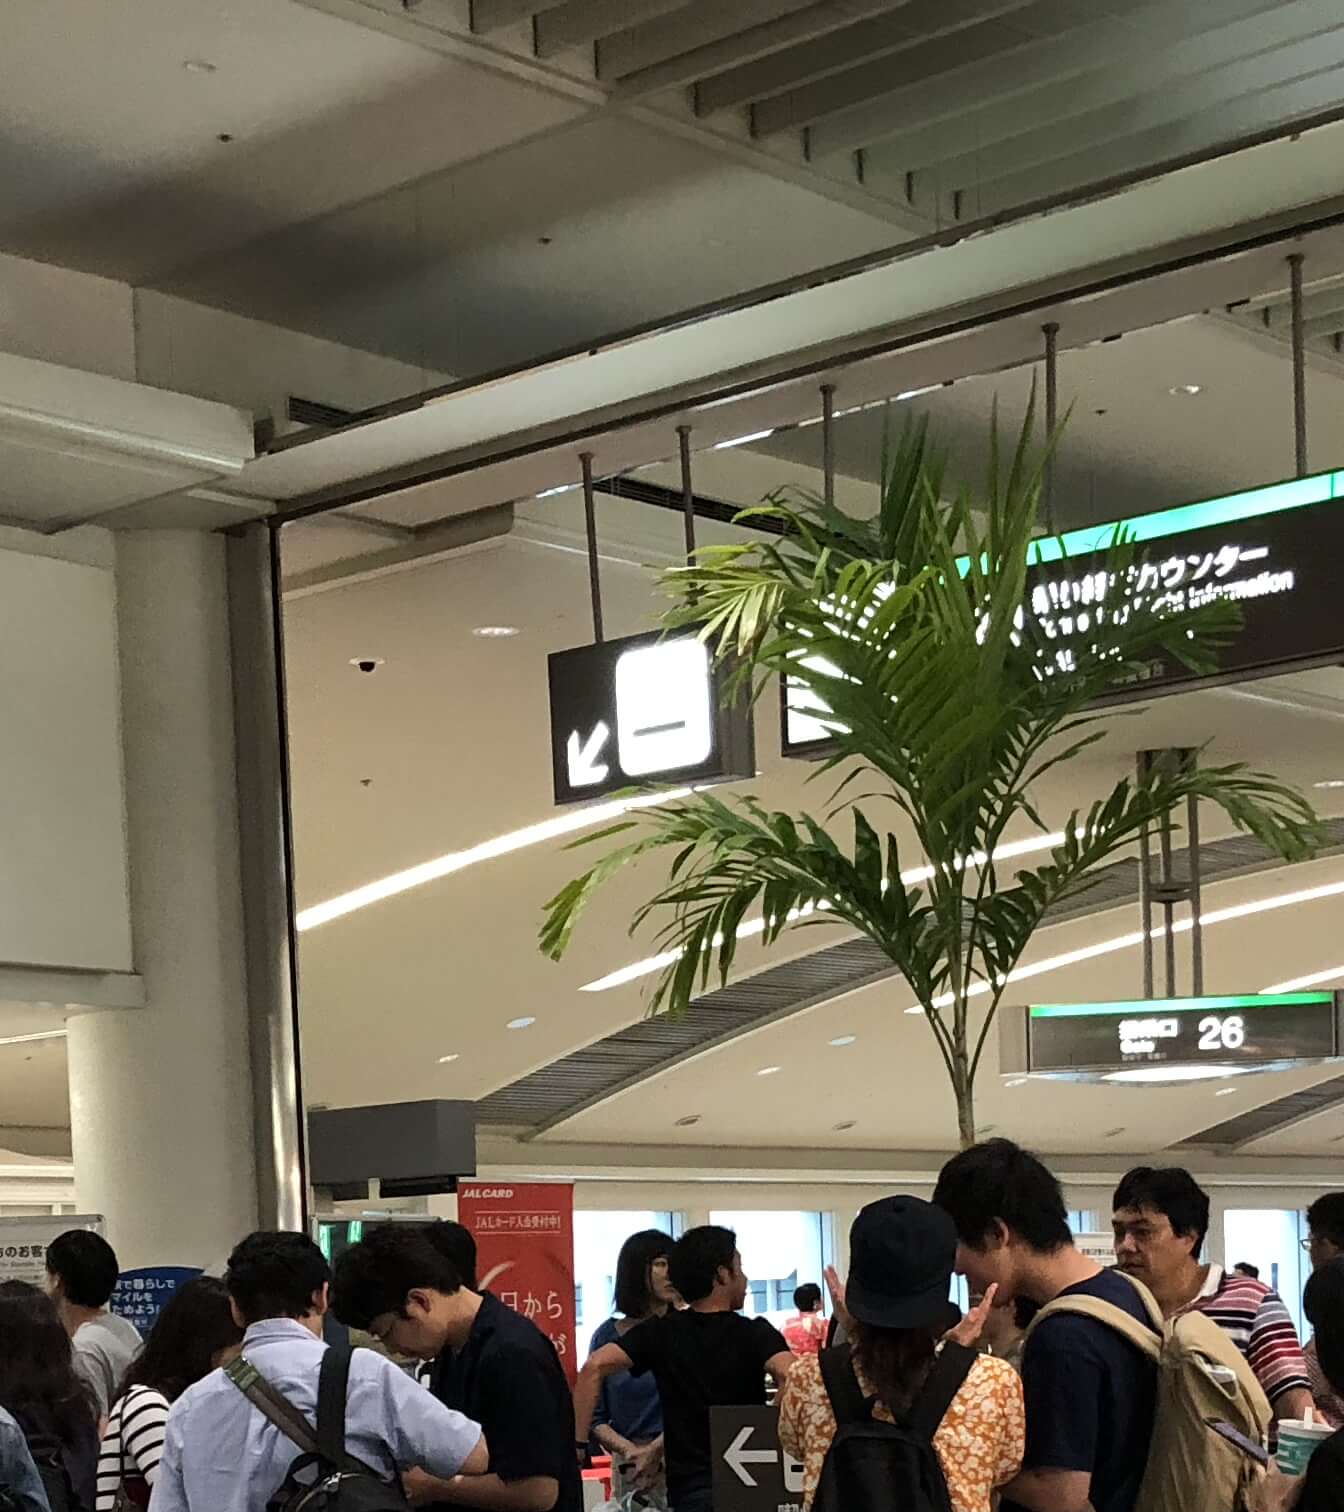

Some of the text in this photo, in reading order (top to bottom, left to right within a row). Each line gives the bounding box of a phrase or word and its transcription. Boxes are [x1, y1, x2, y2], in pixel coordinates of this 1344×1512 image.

[1198, 1016, 1244, 1050] 26
[111, 1292, 153, 1302] マイルを
